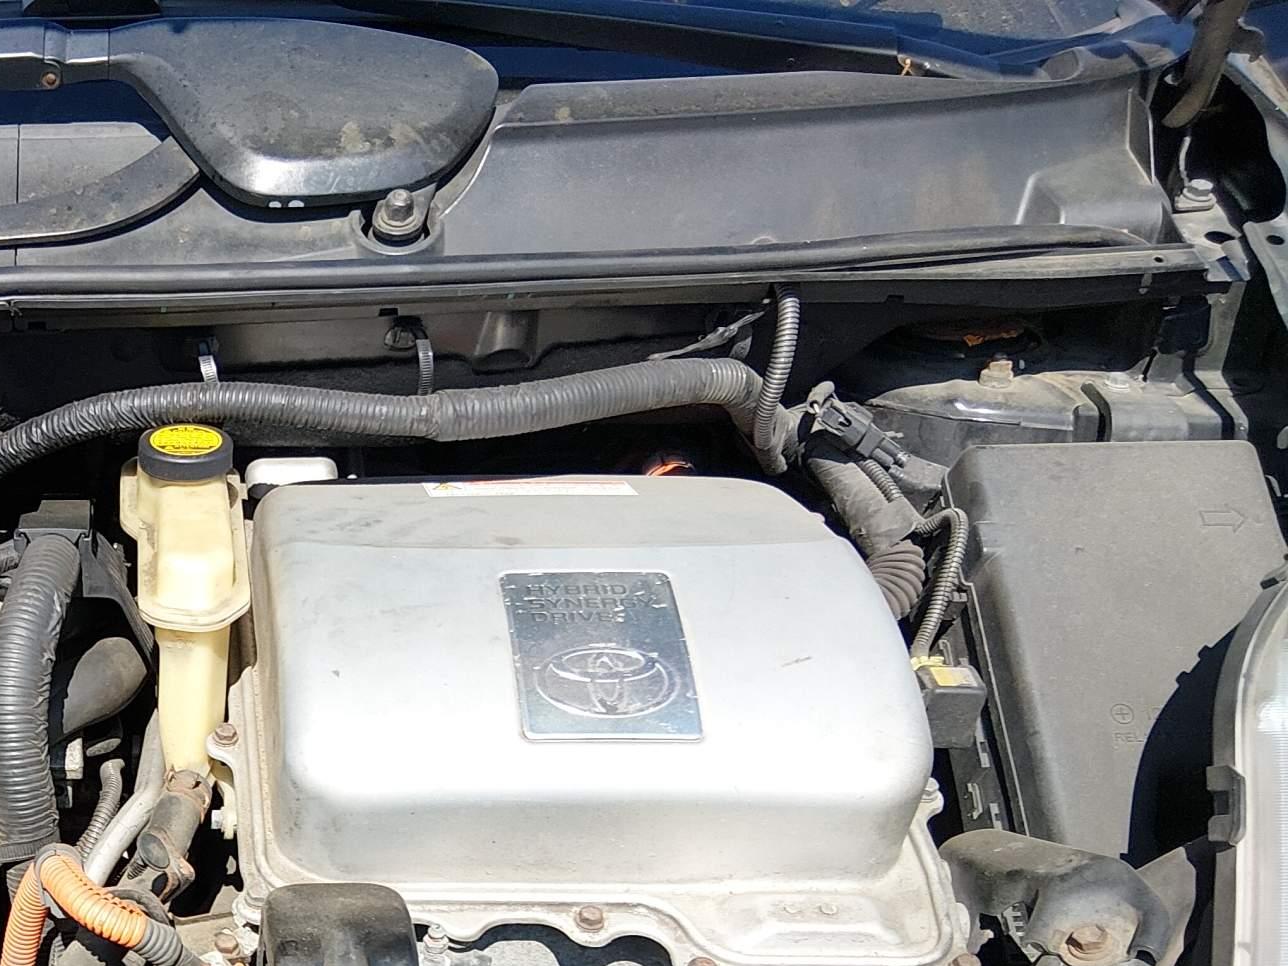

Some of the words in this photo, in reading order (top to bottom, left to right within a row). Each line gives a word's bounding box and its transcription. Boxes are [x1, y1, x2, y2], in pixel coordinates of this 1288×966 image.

[526, 584, 626, 595] HYBRID
[529, 598, 654, 609] SYNERGY
[531, 612, 614, 623] DRIVE
